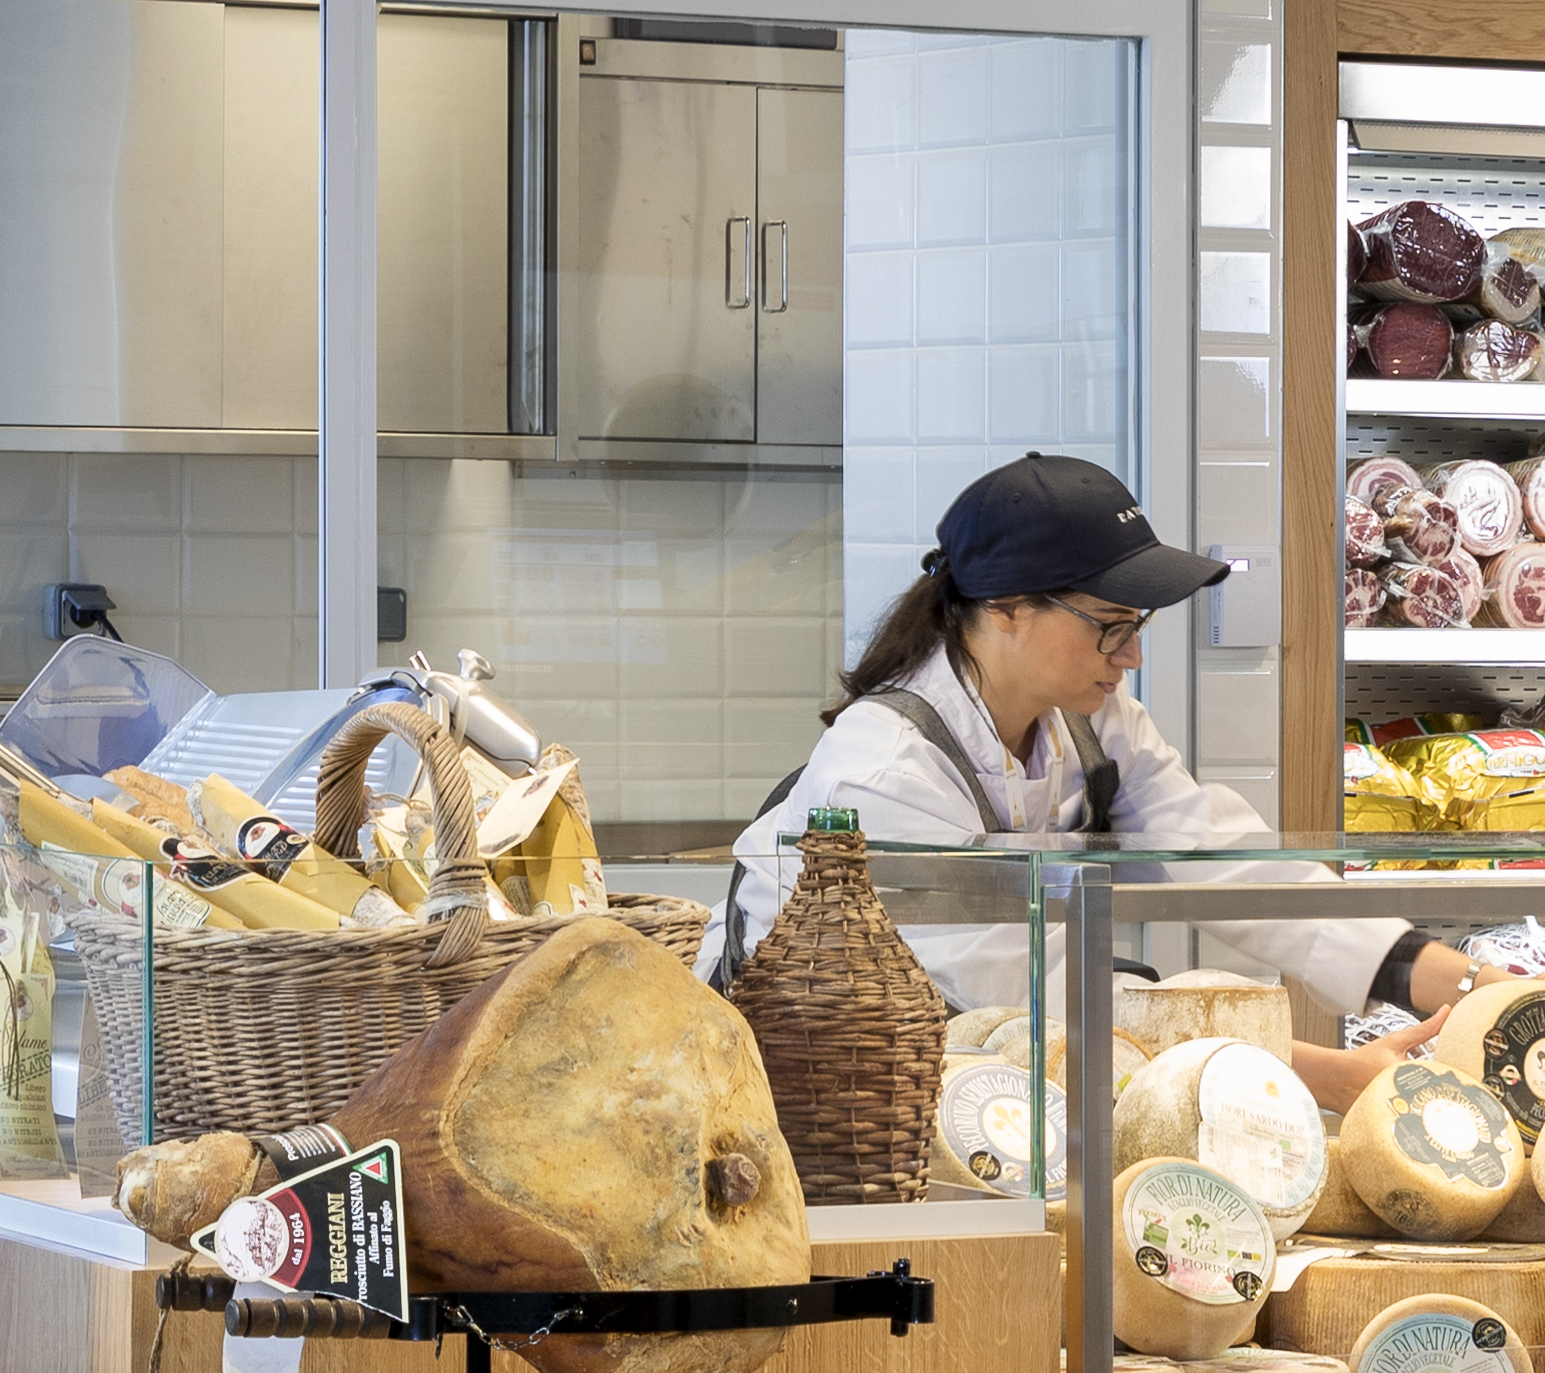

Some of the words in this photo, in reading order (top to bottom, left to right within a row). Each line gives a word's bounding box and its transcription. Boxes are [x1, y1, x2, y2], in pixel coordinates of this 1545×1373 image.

[1221, 1102, 1247, 1119] FIORE
[1249, 1111, 1284, 1133] SARDO
[349, 1172, 366, 1233] BASSIANO
[1146, 1178, 1177, 1206] FIOR
[1177, 1174, 1193, 1197] DI
[1195, 1178, 1247, 1223] NATURA
[1194, 1197, 1227, 1222] VEGETALE
[289, 1212, 305, 1245] 1964
[367, 1211, 378, 1221] al
[379, 1200, 393, 1233] Faggio
[327, 1192, 348, 1285] REGGIANI
[353, 1233, 366, 1247] di
[368, 1221, 380, 1265] Affinato
[381, 1233, 393, 1246] di
[1187, 1236, 1216, 1257] Bio
[291, 1249, 304, 1267] dal
[383, 1248, 395, 1277] Fumo
[1166, 1253, 1178, 1266] IL
[1181, 1257, 1237, 1276] FIORINO
[1392, 1334, 1413, 1360] DI
[1411, 1326, 1471, 1360] NATURA
[1419, 1352, 1456, 1369] VEGETALE
